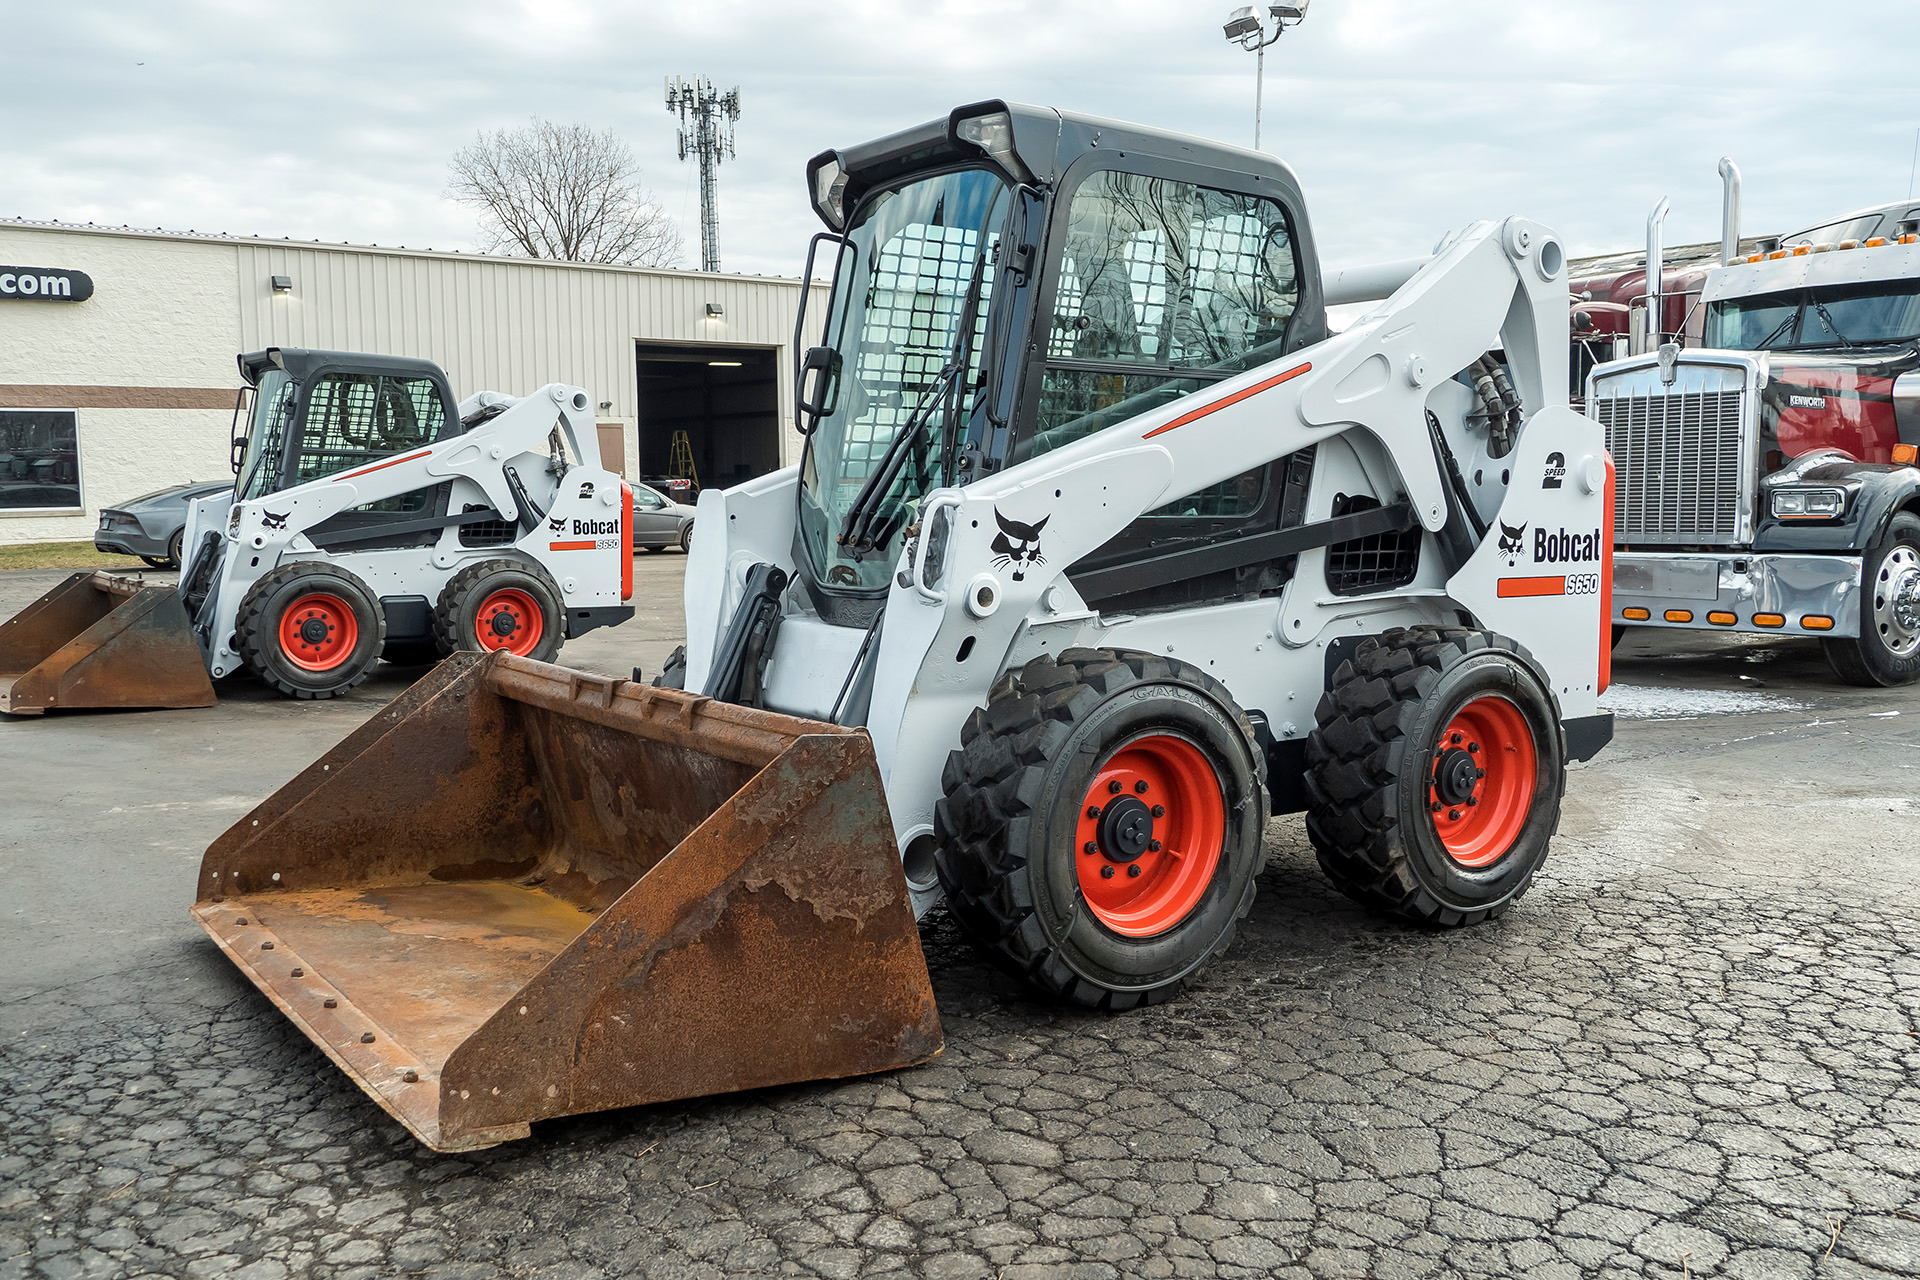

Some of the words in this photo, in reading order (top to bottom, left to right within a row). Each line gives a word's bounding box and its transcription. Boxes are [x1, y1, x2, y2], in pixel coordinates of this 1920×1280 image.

[0, 273, 71, 296] com
[1790, 395, 1825, 408] KENWORTH
[1542, 452, 1566, 489] 2
[1544, 468, 1566, 476] SPEED
[573, 519, 619, 535] Bobcat
[597, 540, 619, 549] S650
[1534, 528, 1600, 563] Bobcat
[1566, 574, 1598, 595] S650
[1132, 684, 1238, 736] GALAXY
